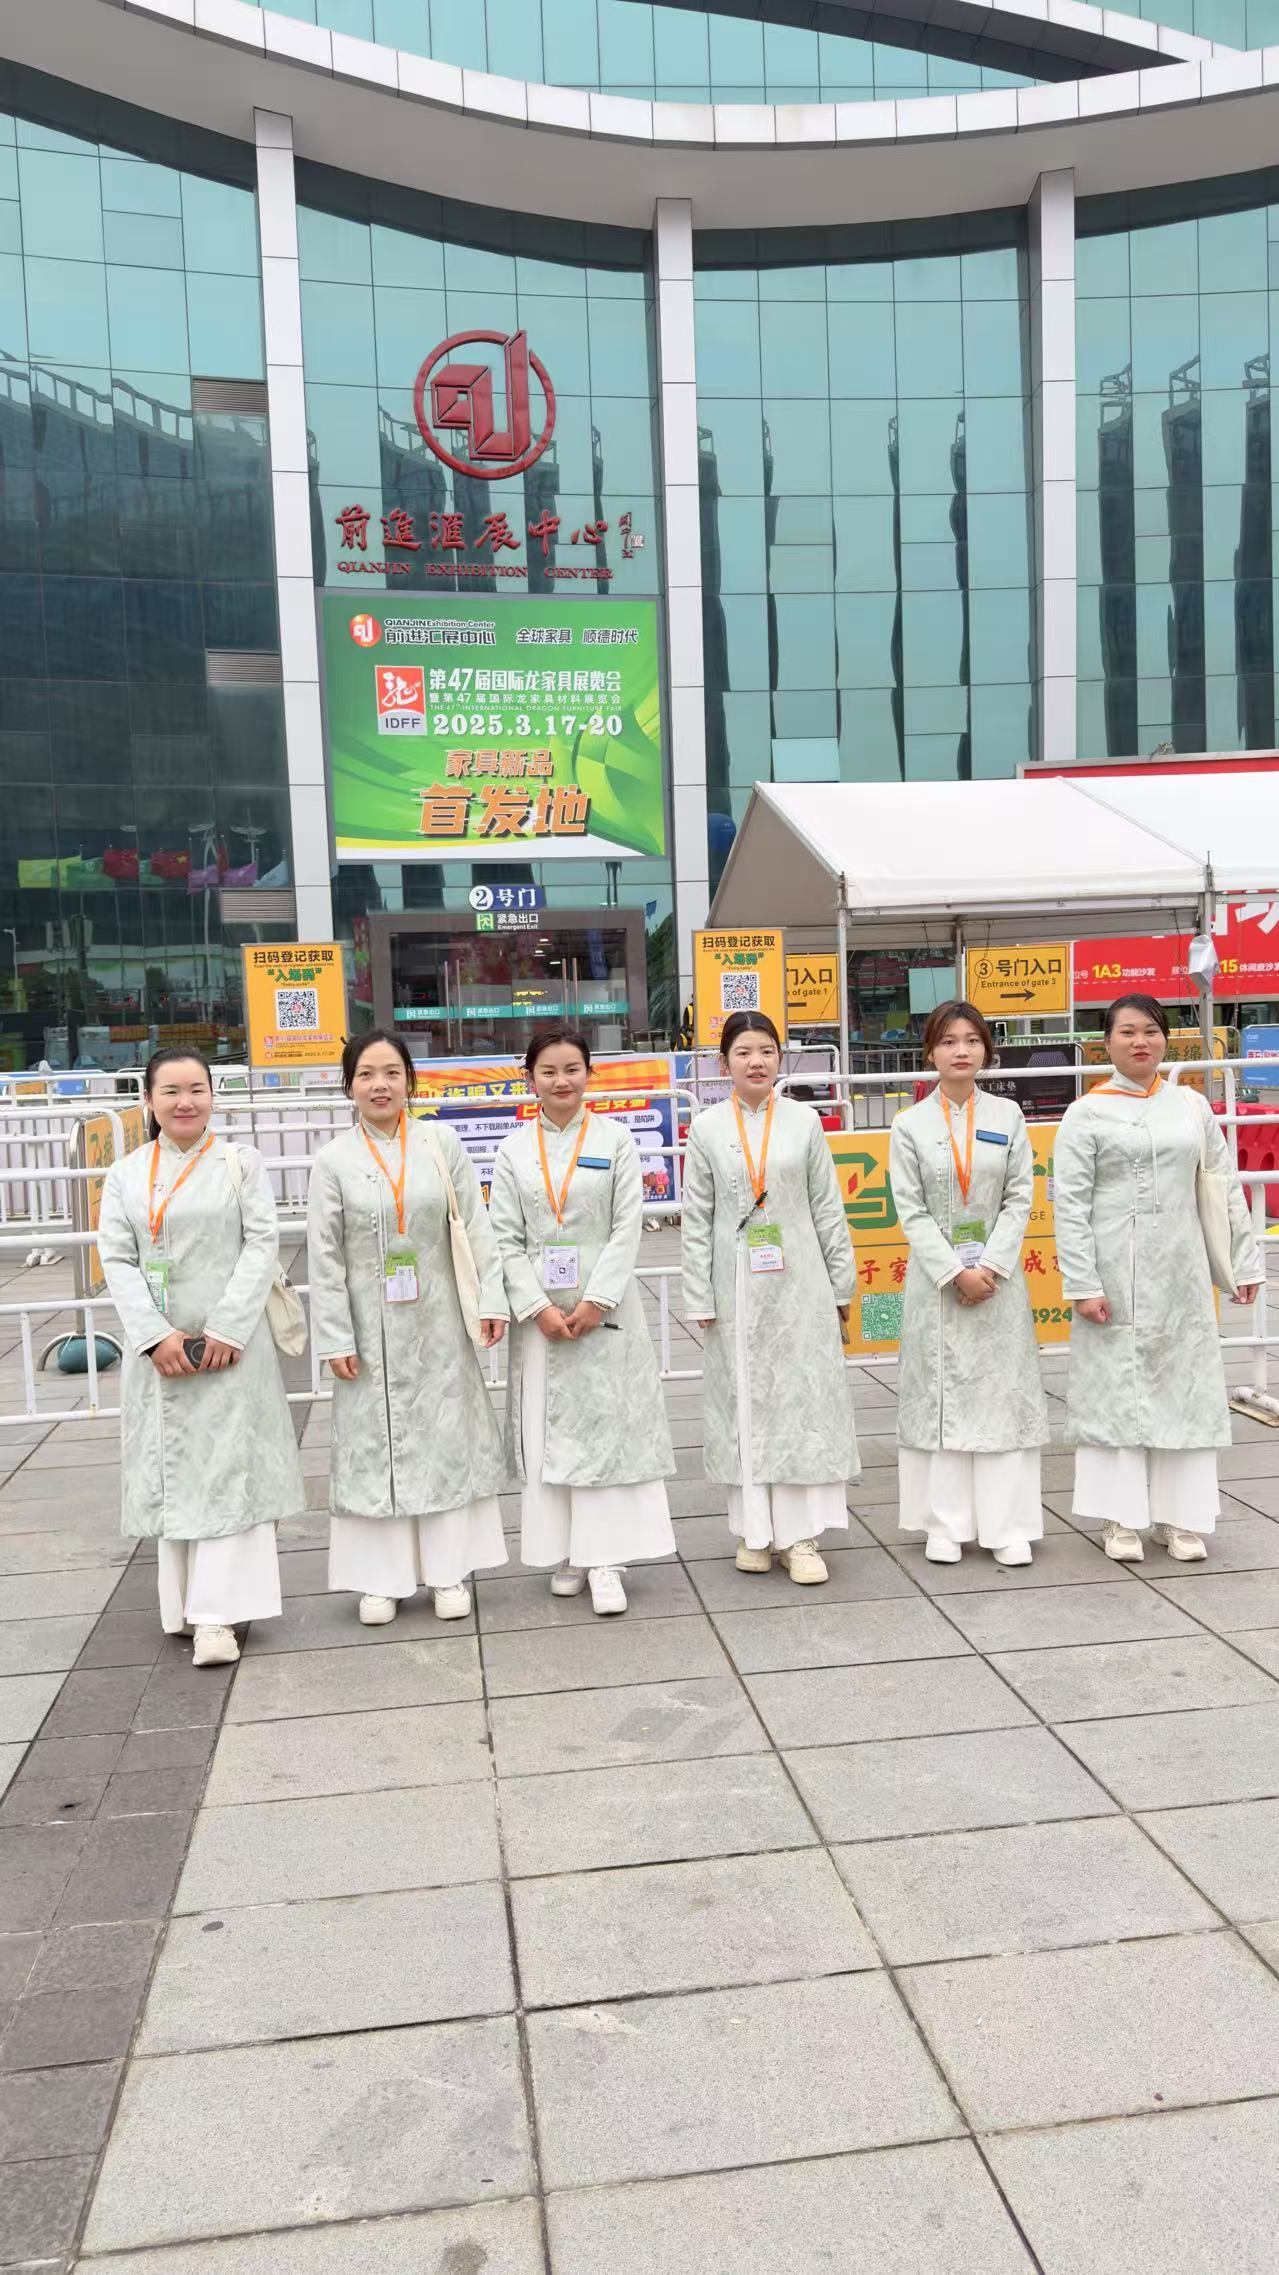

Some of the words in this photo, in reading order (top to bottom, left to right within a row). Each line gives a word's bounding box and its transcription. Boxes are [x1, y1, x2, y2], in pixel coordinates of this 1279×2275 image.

[337, 561, 411, 574] QIANJIN
[425, 563, 528, 577] EXHIBITION
[544, 567, 613, 579] CENTER
[386, 629, 495, 644] 前进汇展中心
[517, 628, 571, 643] 全球家具
[583, 629, 638, 643] 顺德时代
[429, 668, 621, 691] 第47届国际龙家具展览会
[429, 692, 621, 704] 暨第47届国际龙家具材料展览会
[462, 704, 523, 712] INTERNATIONAL
[385, 717, 421, 729] IDFF
[433, 714, 623, 736] 2025.3.17-20
[445, 748, 554, 777] 家具新品
[415, 783, 592, 838] 首发地
[497, 913, 539, 923] 紧急出口
[703, 935, 775, 953] 扫码登记获取
[254, 950, 334, 963] 扫码登记获取
[1092, 964, 1121, 978] 1A3
[792, 988, 801, 996] of
[803, 988, 821, 997] gate
